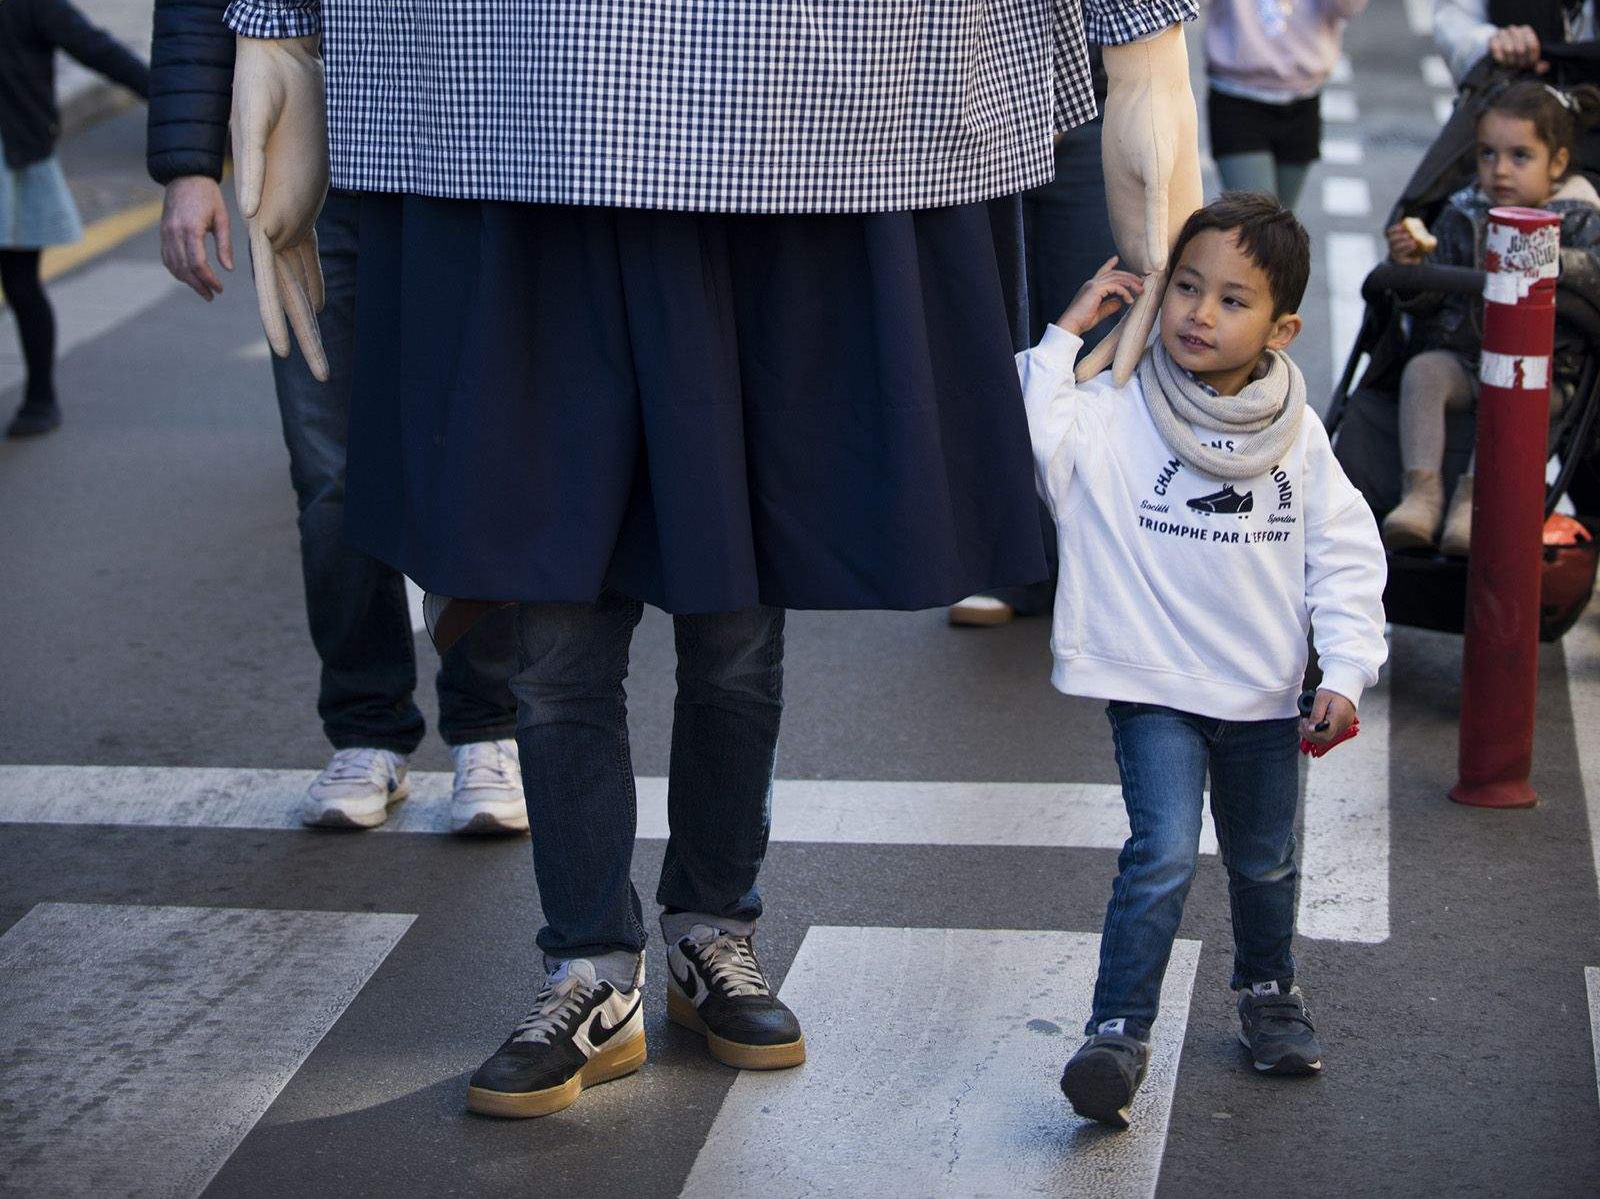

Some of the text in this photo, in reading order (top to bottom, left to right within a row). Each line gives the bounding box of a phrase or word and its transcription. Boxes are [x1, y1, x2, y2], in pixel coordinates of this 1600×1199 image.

[1138, 515, 1290, 544] TRIOMPHE PAR L'EFFORT
